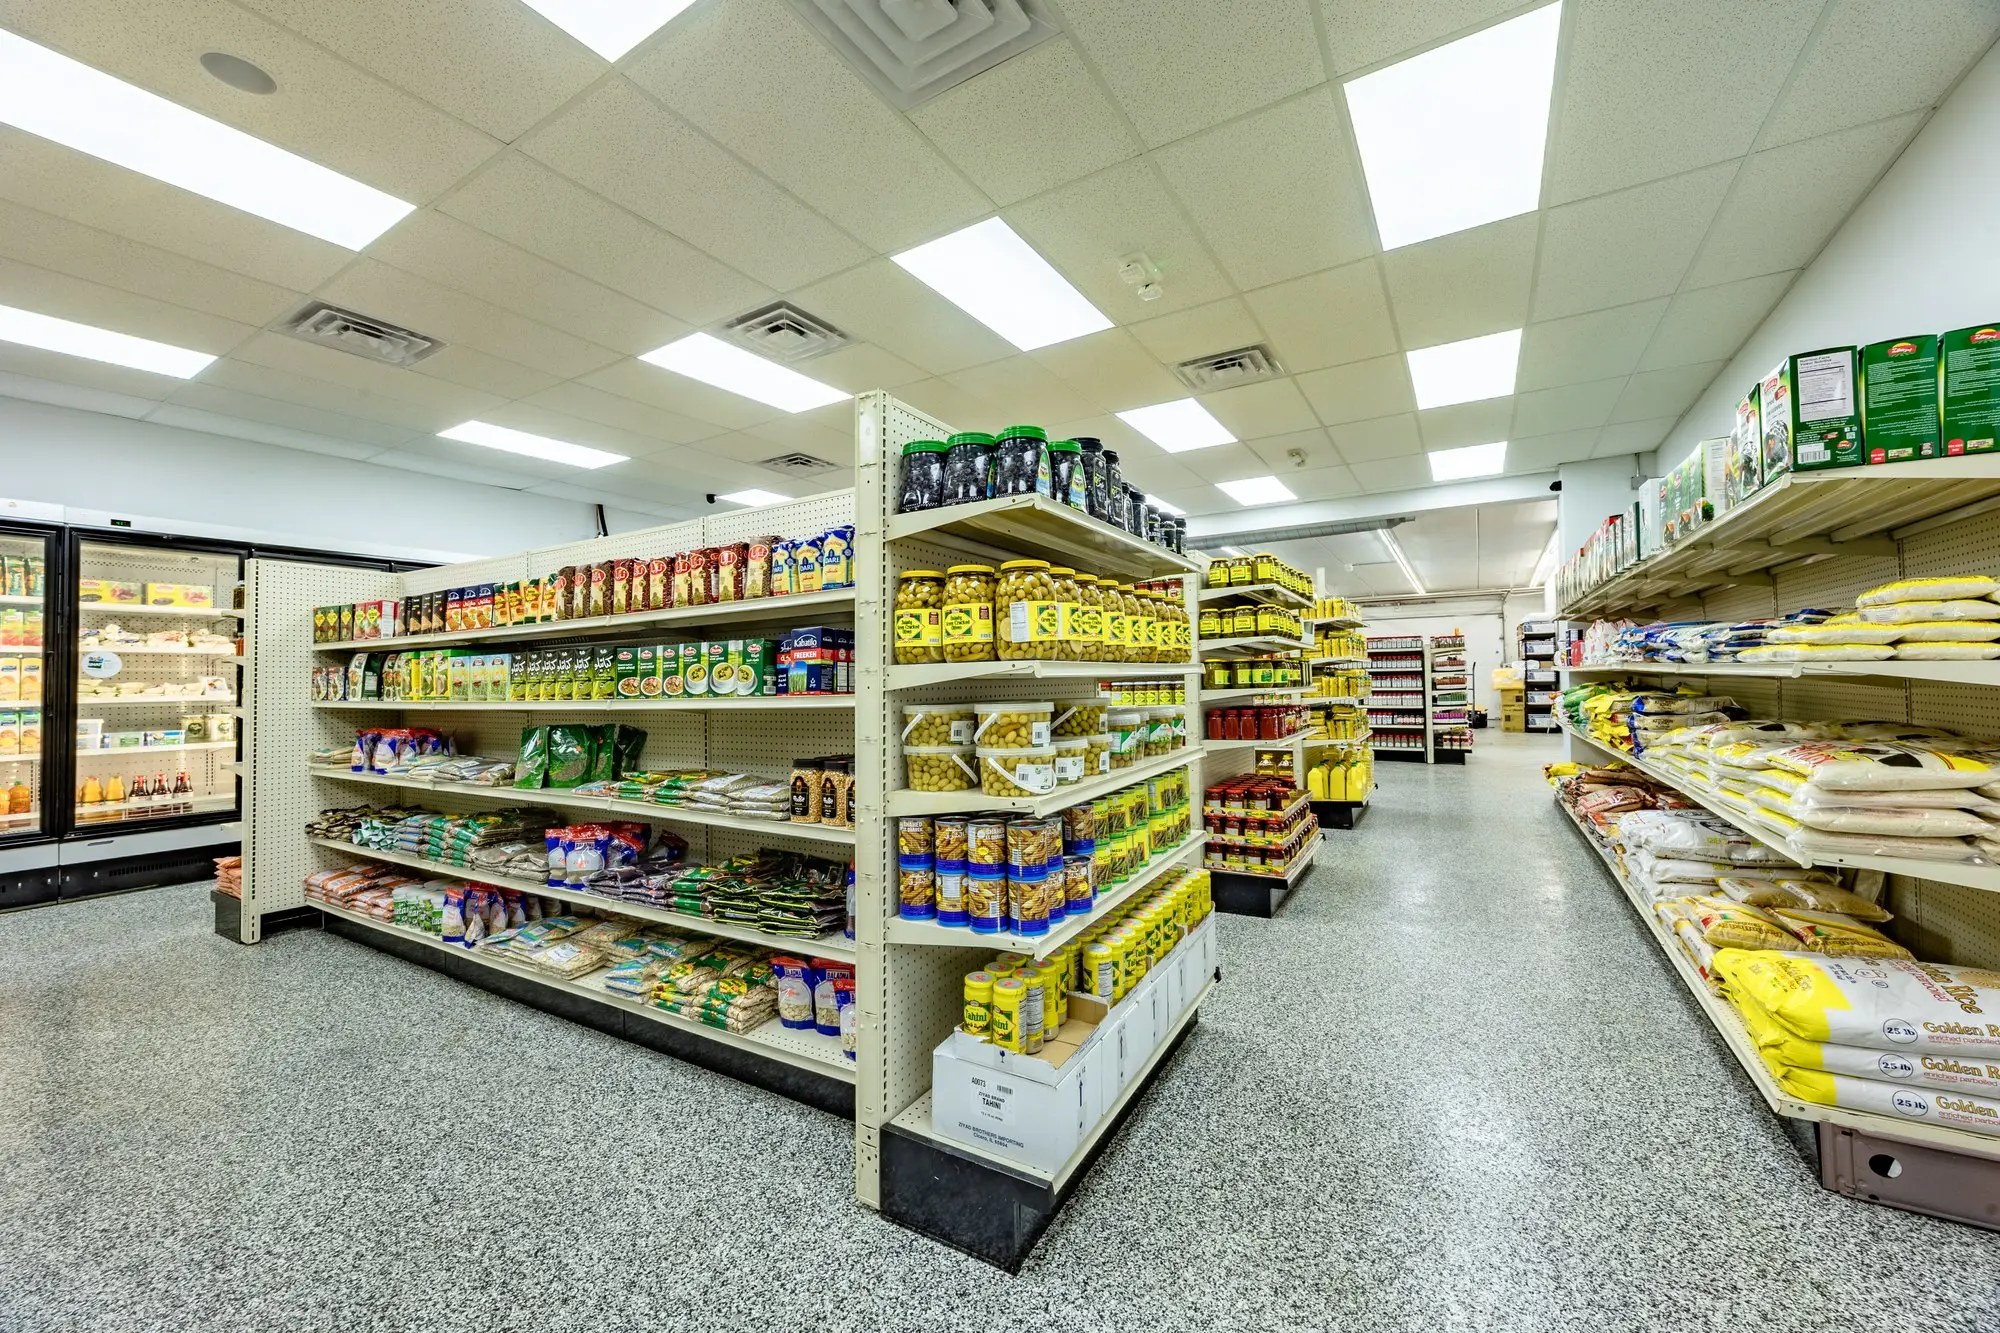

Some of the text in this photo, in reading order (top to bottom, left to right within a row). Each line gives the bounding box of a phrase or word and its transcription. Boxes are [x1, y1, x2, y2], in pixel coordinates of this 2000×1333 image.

[800, 564, 814, 572] DARI
[1941, 985, 1982, 1014] Rice
[966, 1009, 987, 1022] Tahini
[1887, 1027, 1901, 1035] 25
[1923, 1022, 1985, 1036] Golden
[1882, 1062, 1898, 1070] 25
[1921, 1057, 1983, 1077] Golden
[1960, 1076, 1998, 1087] parboiled
[982, 1098, 1001, 1110] TAHINI
[1897, 1099, 1926, 1110] 25 lb
[1936, 1096, 1998, 1118] Golden
[972, 1126, 997, 1139] BROTHERS
[998, 1135, 1024, 1148] IMPORTING
